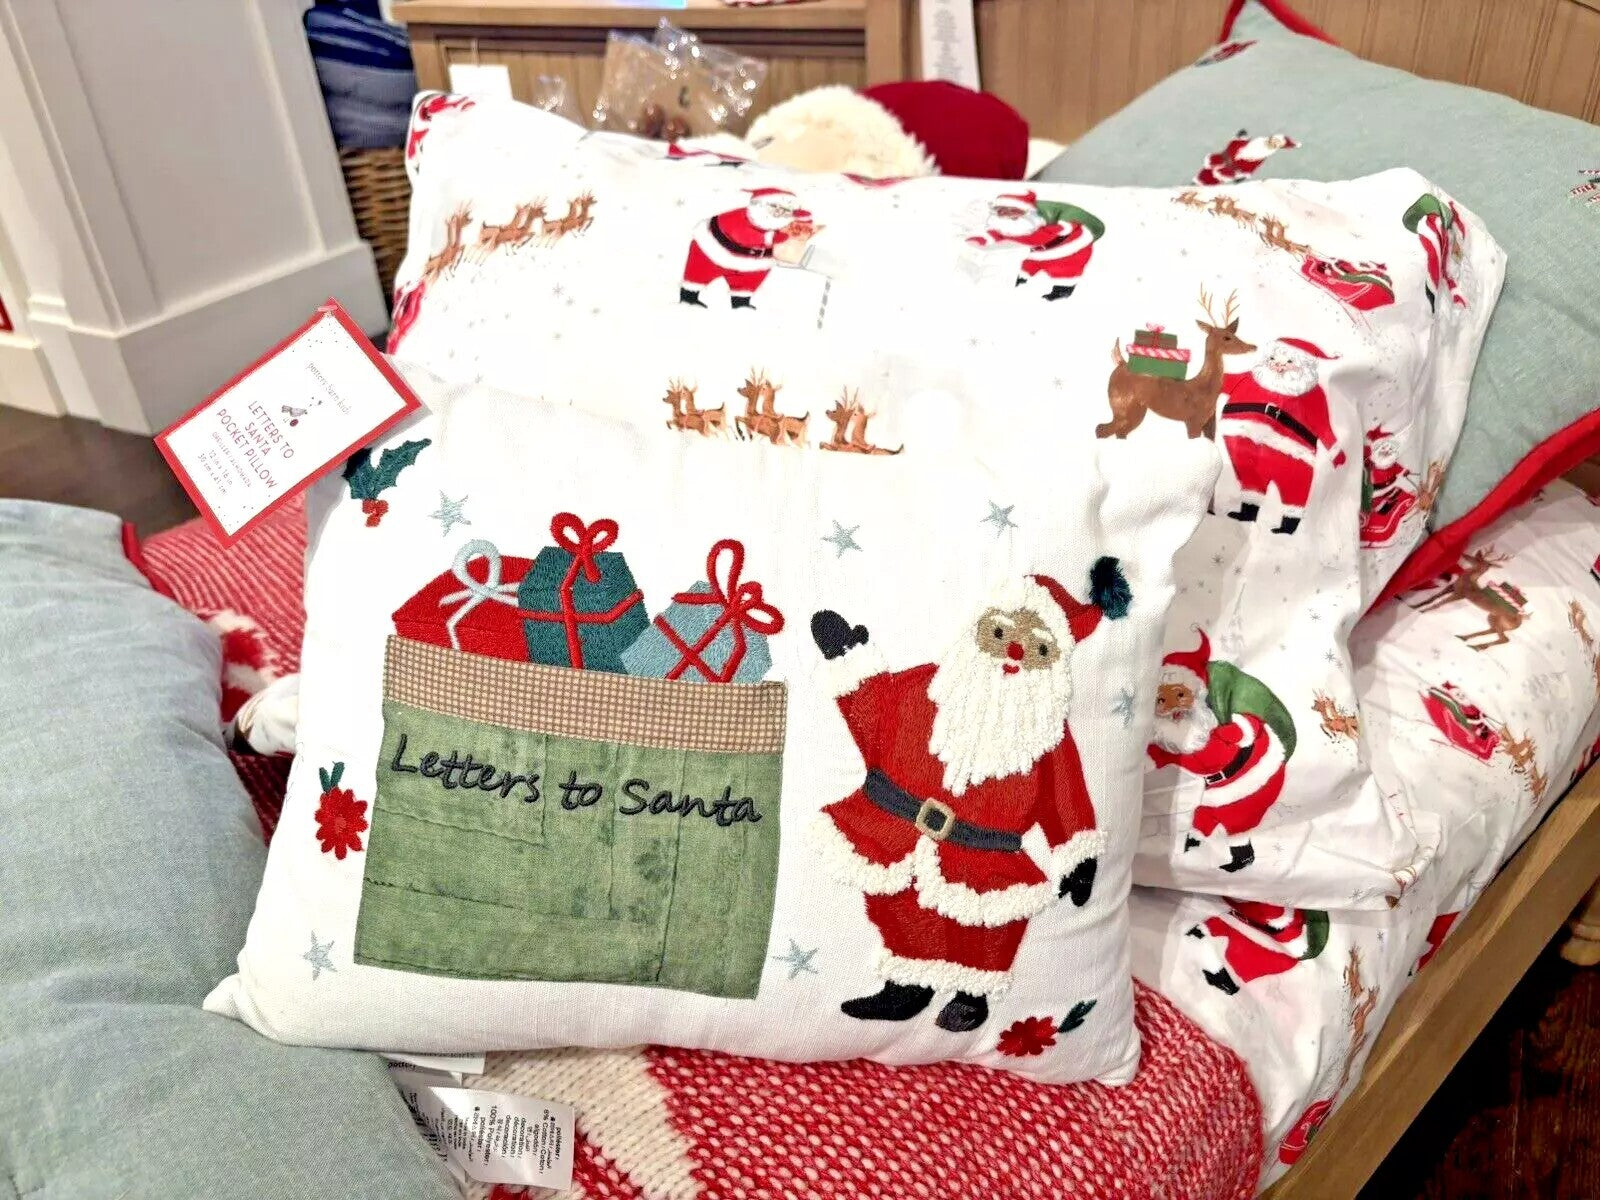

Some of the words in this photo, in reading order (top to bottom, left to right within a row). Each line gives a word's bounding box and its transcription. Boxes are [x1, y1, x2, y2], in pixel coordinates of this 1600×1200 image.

[214, 407, 249, 451] POCKET
[242, 447, 278, 491] PILLOW
[243, 421, 273, 456] SANTA
[247, 399, 284, 444] LETTERS
[277, 441, 295, 460] TO
[390, 733, 541, 803] Letters
[558, 770, 603, 811] to
[618, 777, 764, 828] Santa
